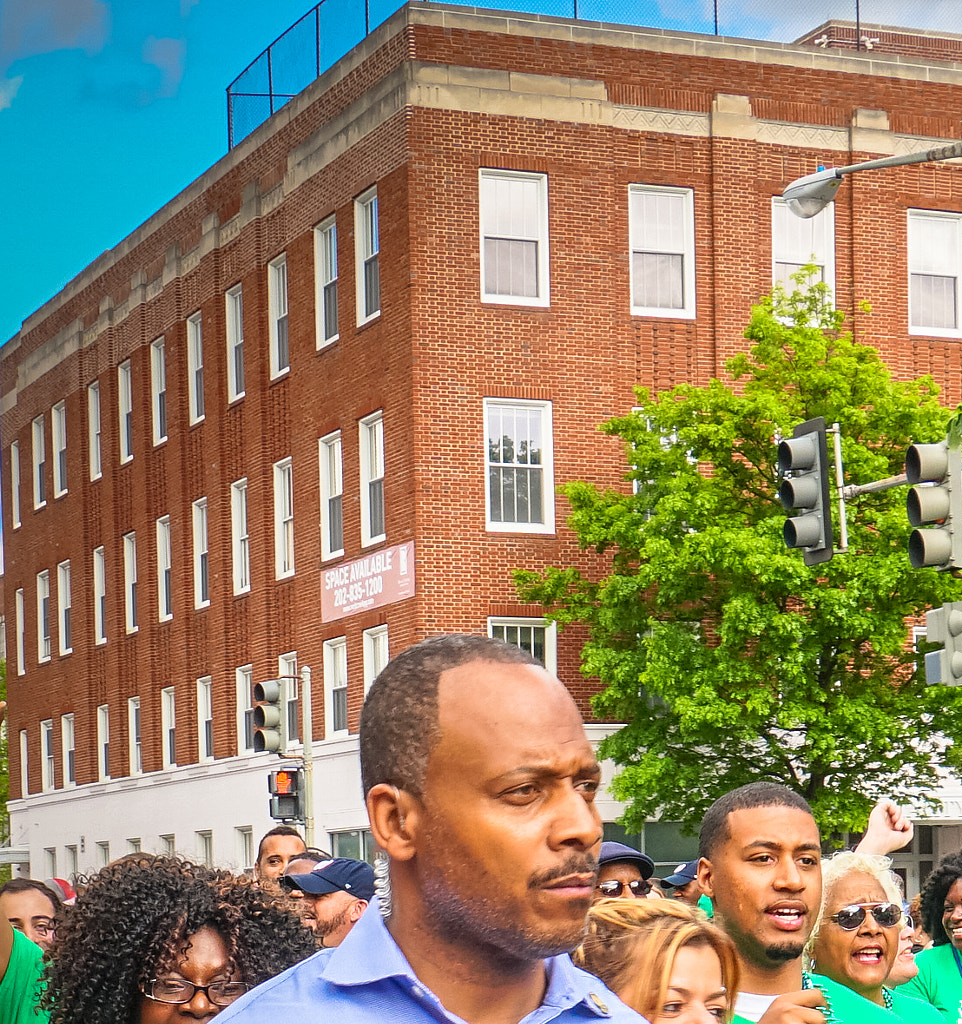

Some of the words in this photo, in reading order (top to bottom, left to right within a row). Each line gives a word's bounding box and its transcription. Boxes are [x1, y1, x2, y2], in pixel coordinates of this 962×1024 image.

[325, 565, 350, 590] SPACE
[350, 551, 393, 583] AVAILABLE
[333, 576, 383, 608] 202-835-1200
